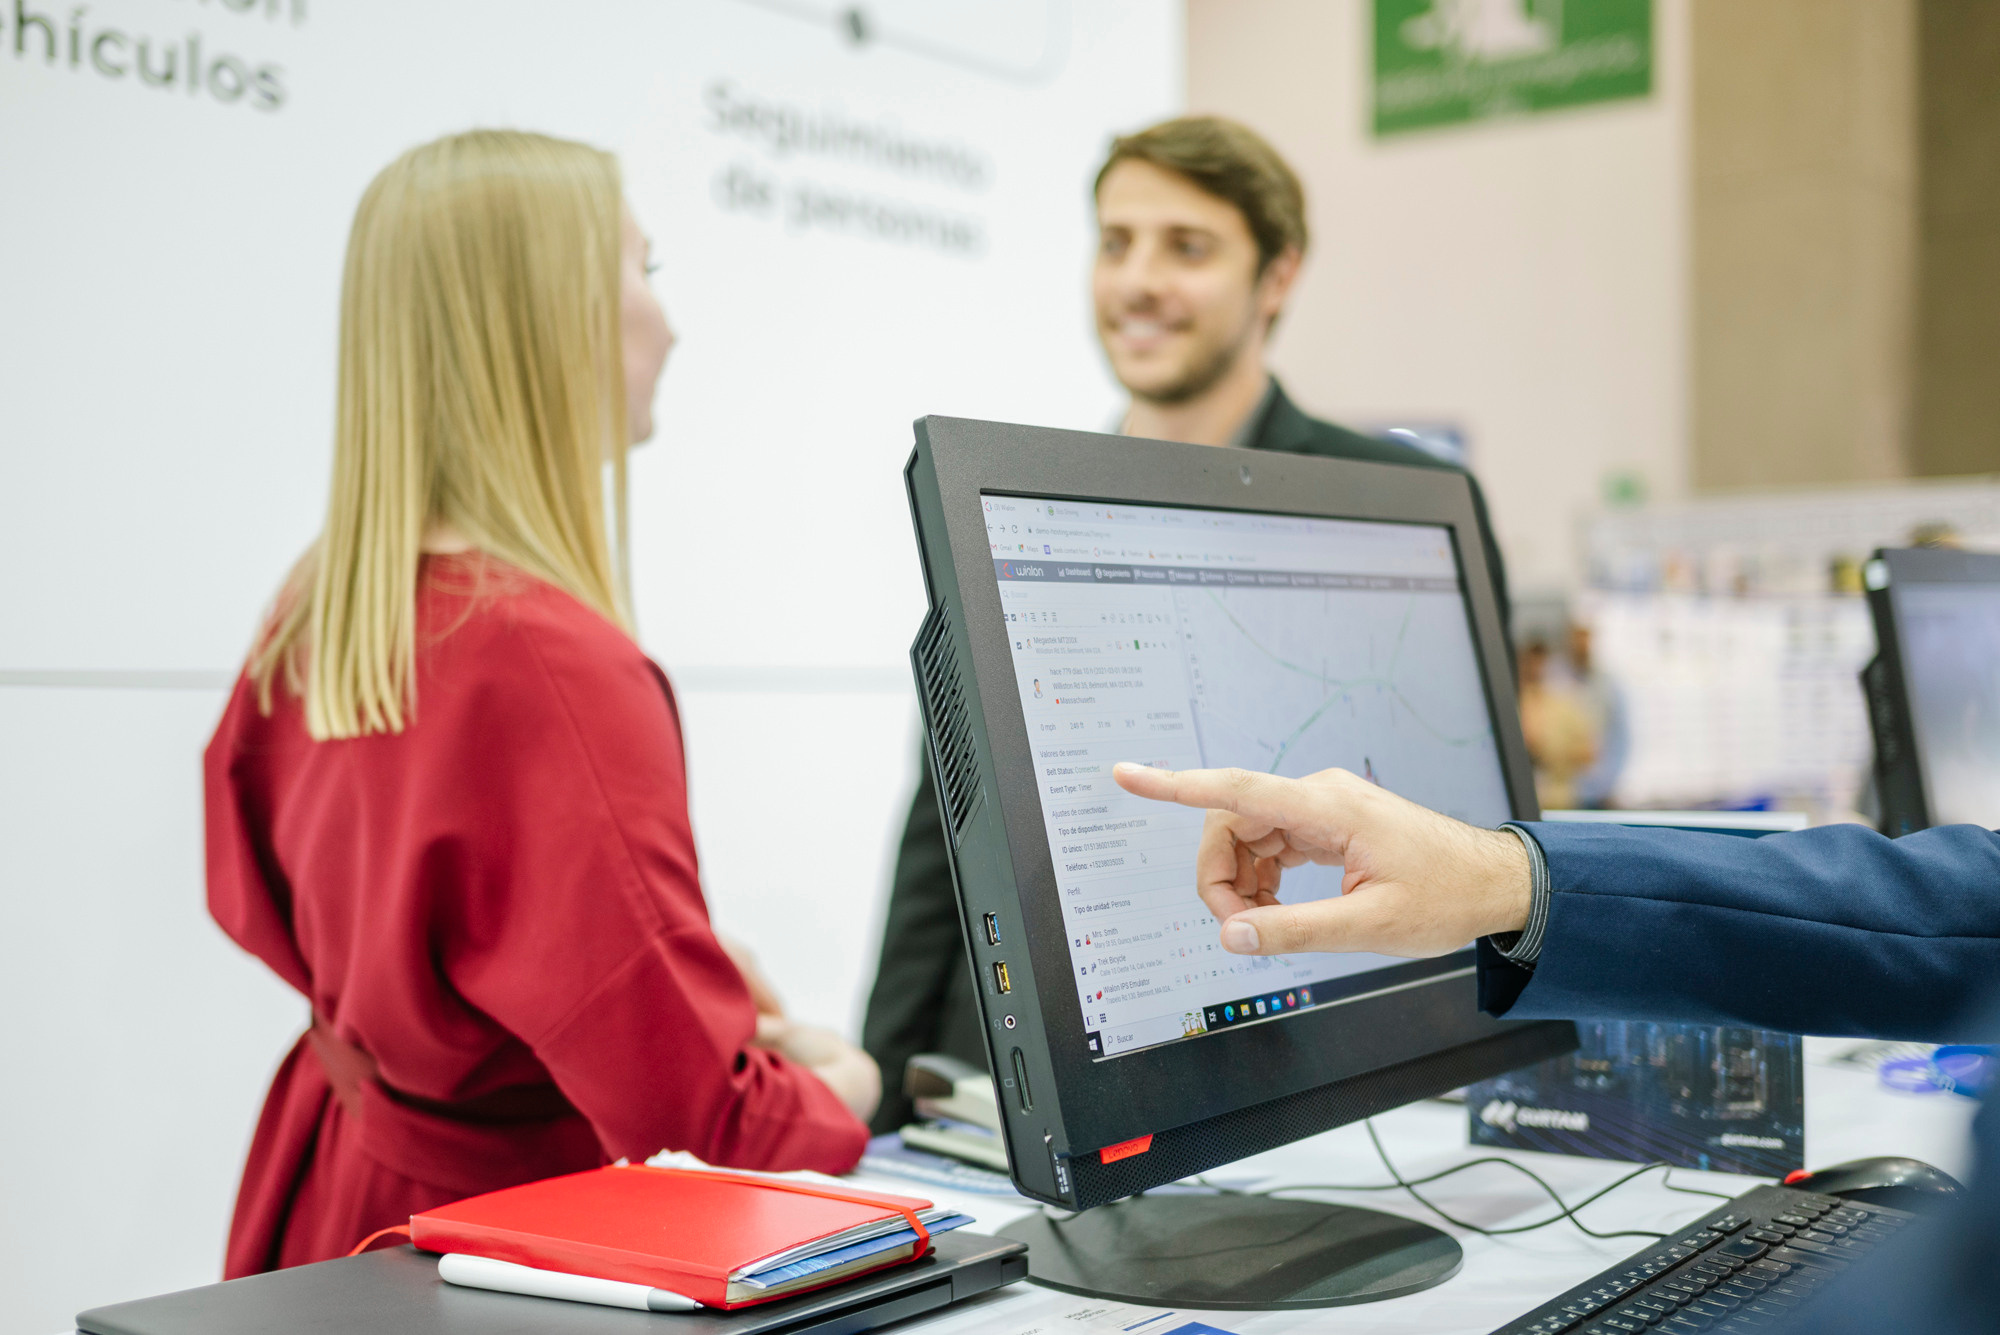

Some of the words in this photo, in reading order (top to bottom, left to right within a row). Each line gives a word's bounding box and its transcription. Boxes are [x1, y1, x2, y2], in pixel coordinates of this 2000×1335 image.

[0, 0, 288, 112] hículos
[706, 80, 988, 188] Seguimiento
[718, 164, 774, 213] de
[794, 184, 984, 256] personas
[1015, 564, 1044, 577] wialon
[1065, 567, 1092, 577] Dashboard
[1040, 750, 1058, 759] Valores
[1050, 786, 1064, 794] Event
[1078, 784, 1092, 792] Timer
[1052, 809, 1070, 819] Ajustes
[1058, 828, 1070, 837] Tipo
[1074, 906, 1085, 915] Tipo
[1111, 899, 1131, 908] Persona
[1104, 927, 1119, 937] Smith
[1097, 958, 1108, 966] Trek
[1109, 954, 1126, 964] Bicycle
[1103, 983, 1120, 994] Wialon
[1129, 978, 1150, 989] Emulator
[1116, 1033, 1134, 1044] Buscar
[1108, 1142, 1139, 1160] Lenovo
